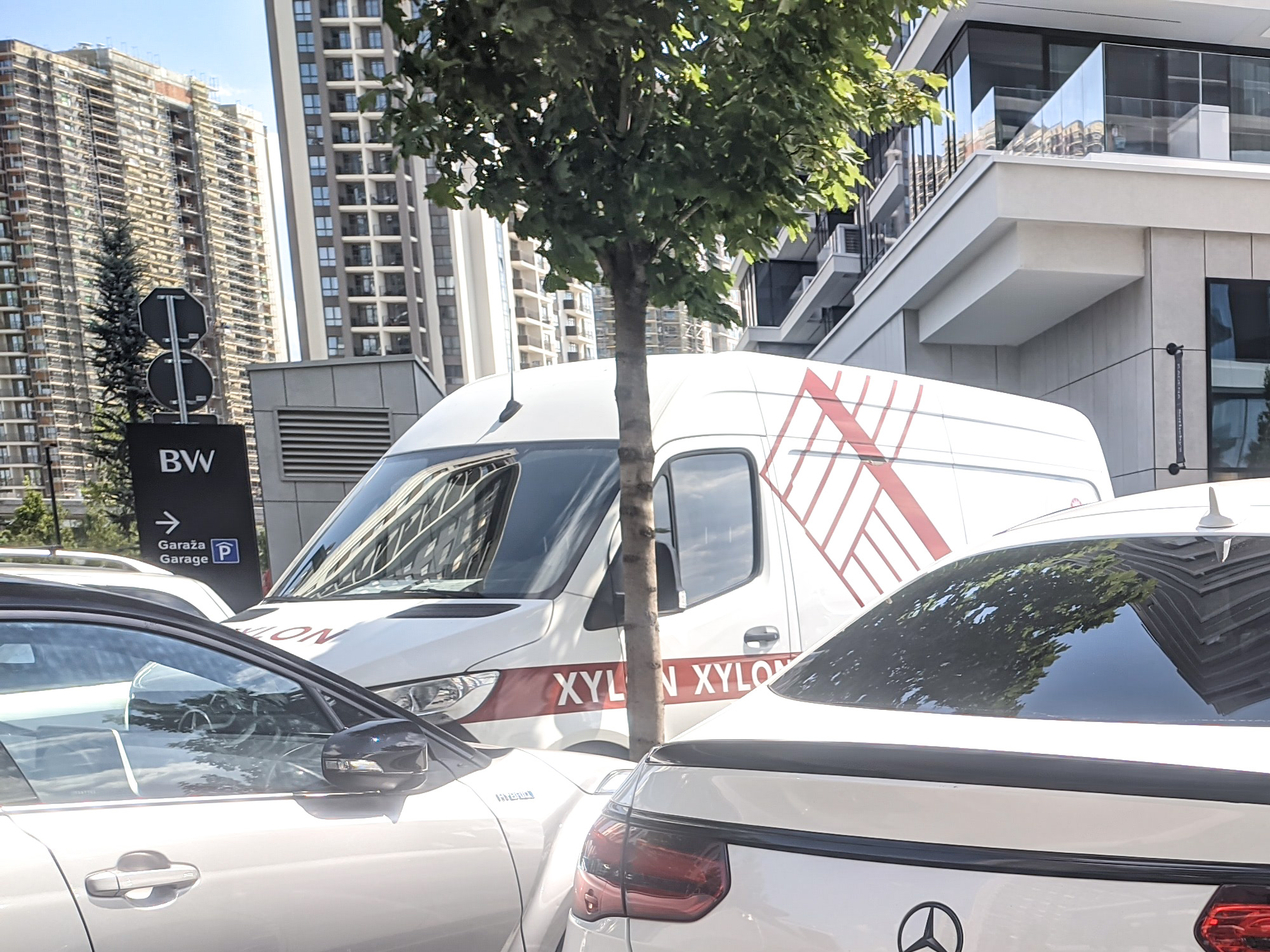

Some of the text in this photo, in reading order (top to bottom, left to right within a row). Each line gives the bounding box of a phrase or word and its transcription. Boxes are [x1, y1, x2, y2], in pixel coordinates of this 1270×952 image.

[158, 448, 216, 474] BW
[158, 539, 206, 551] Garaža
[159, 554, 209, 567] Garage
[553, 665, 678, 706] XYLN
